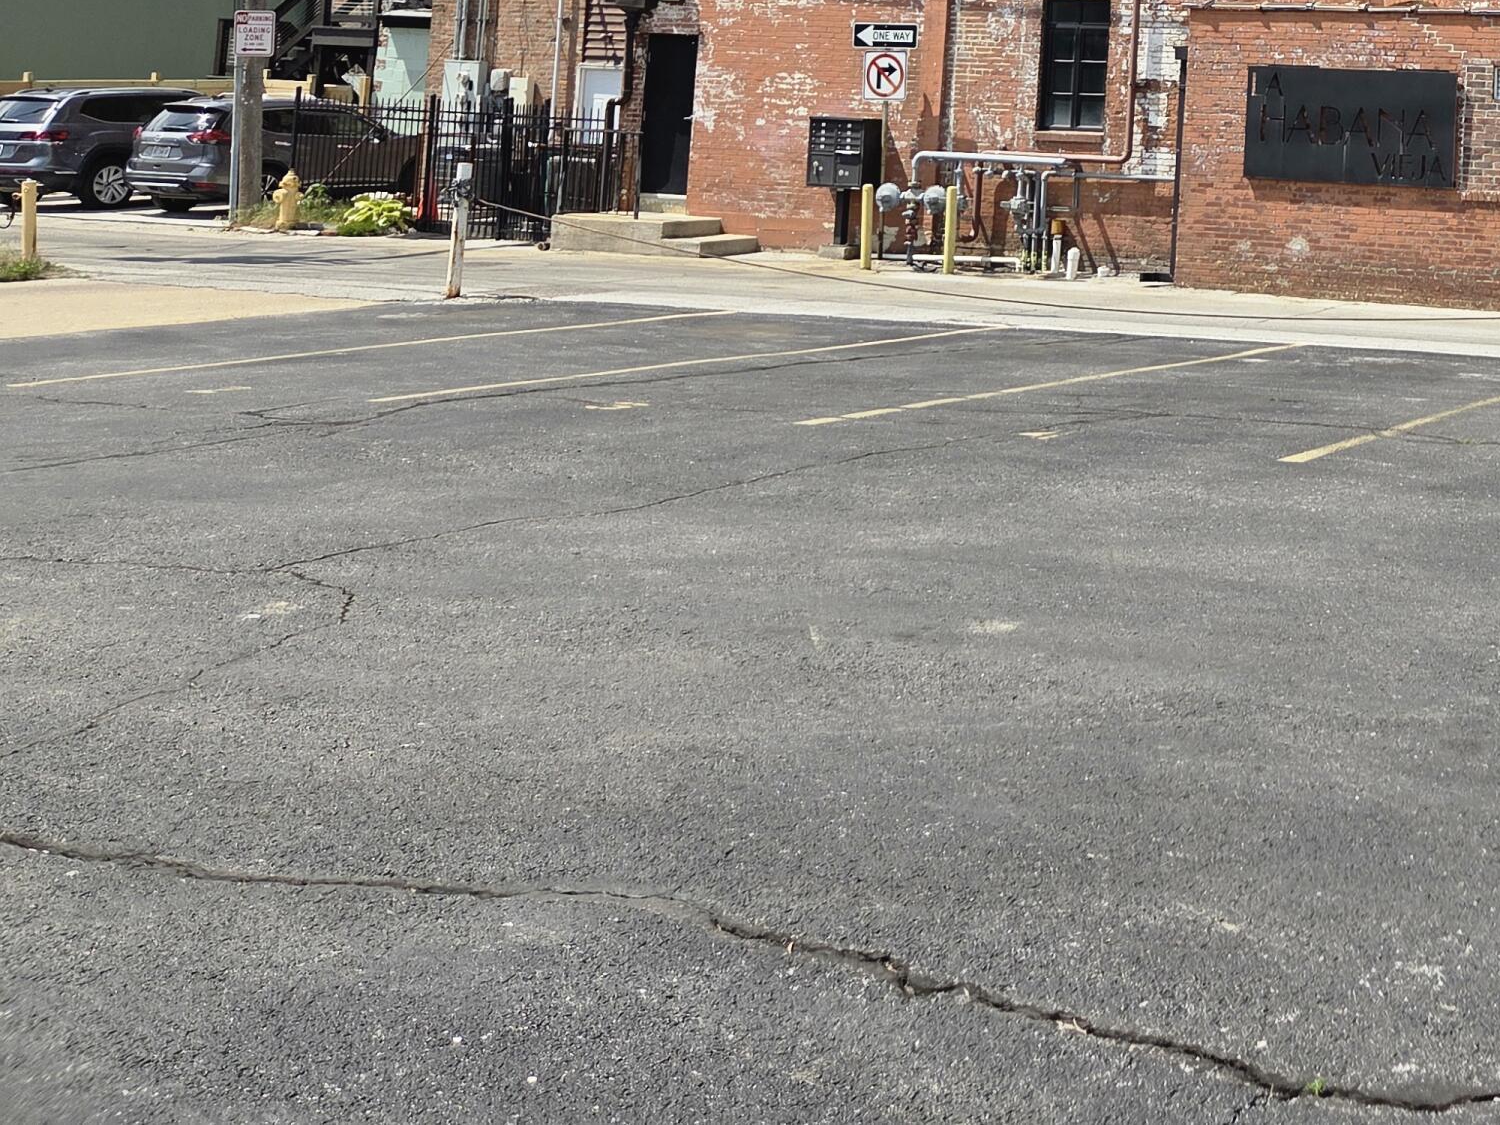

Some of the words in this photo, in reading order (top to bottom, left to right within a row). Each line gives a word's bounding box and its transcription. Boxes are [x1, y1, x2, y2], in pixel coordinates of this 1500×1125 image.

[236, 13, 248, 23] NO
[872, 31, 890, 41] ONE
[893, 31, 911, 41] WAY
[1259, 104, 1434, 149] HABANA
[1371, 153, 1446, 182] VIEJA
